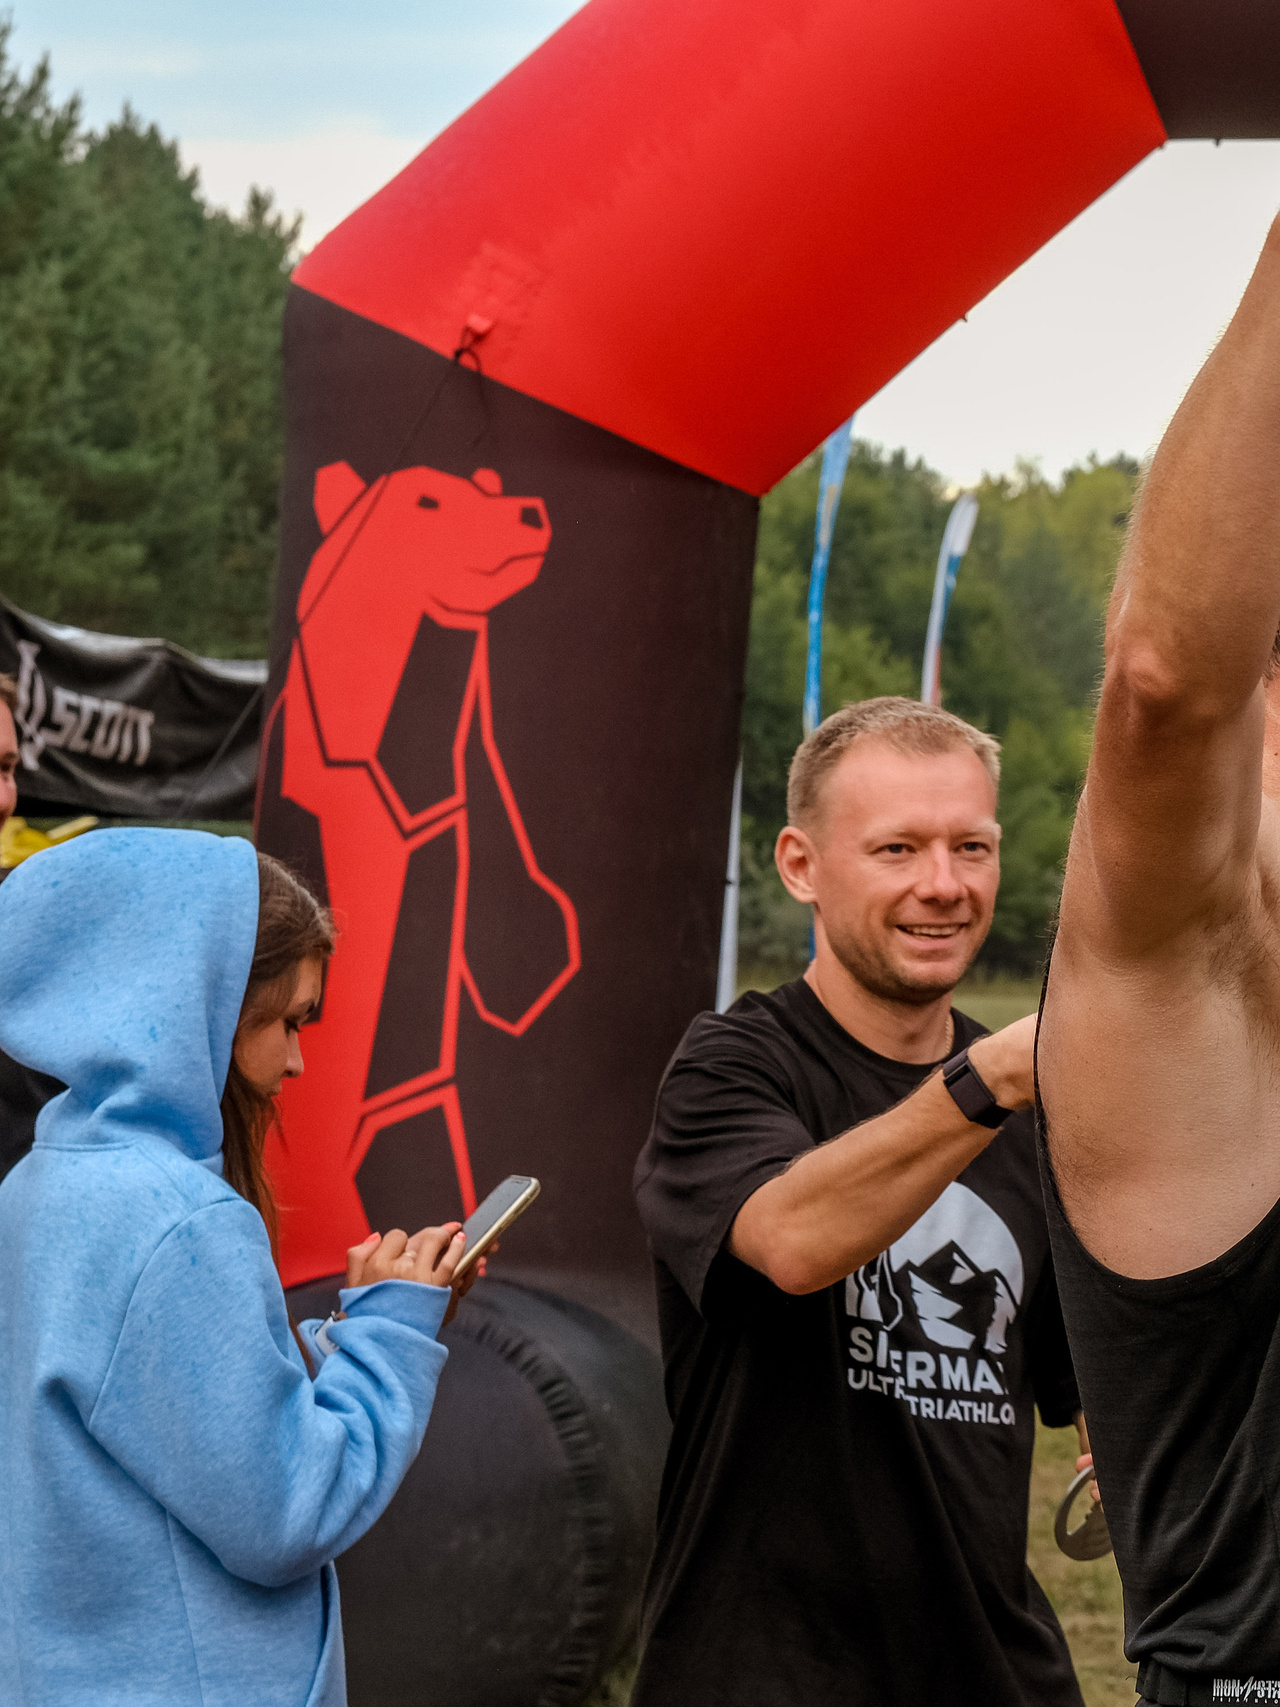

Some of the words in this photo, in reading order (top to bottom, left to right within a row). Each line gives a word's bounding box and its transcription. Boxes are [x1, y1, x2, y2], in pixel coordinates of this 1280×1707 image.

[849, 1326, 1009, 1395] SIERMA
[848, 1368, 906, 1400] ULTR
[905, 1395, 1016, 1425] TRIATHLO
